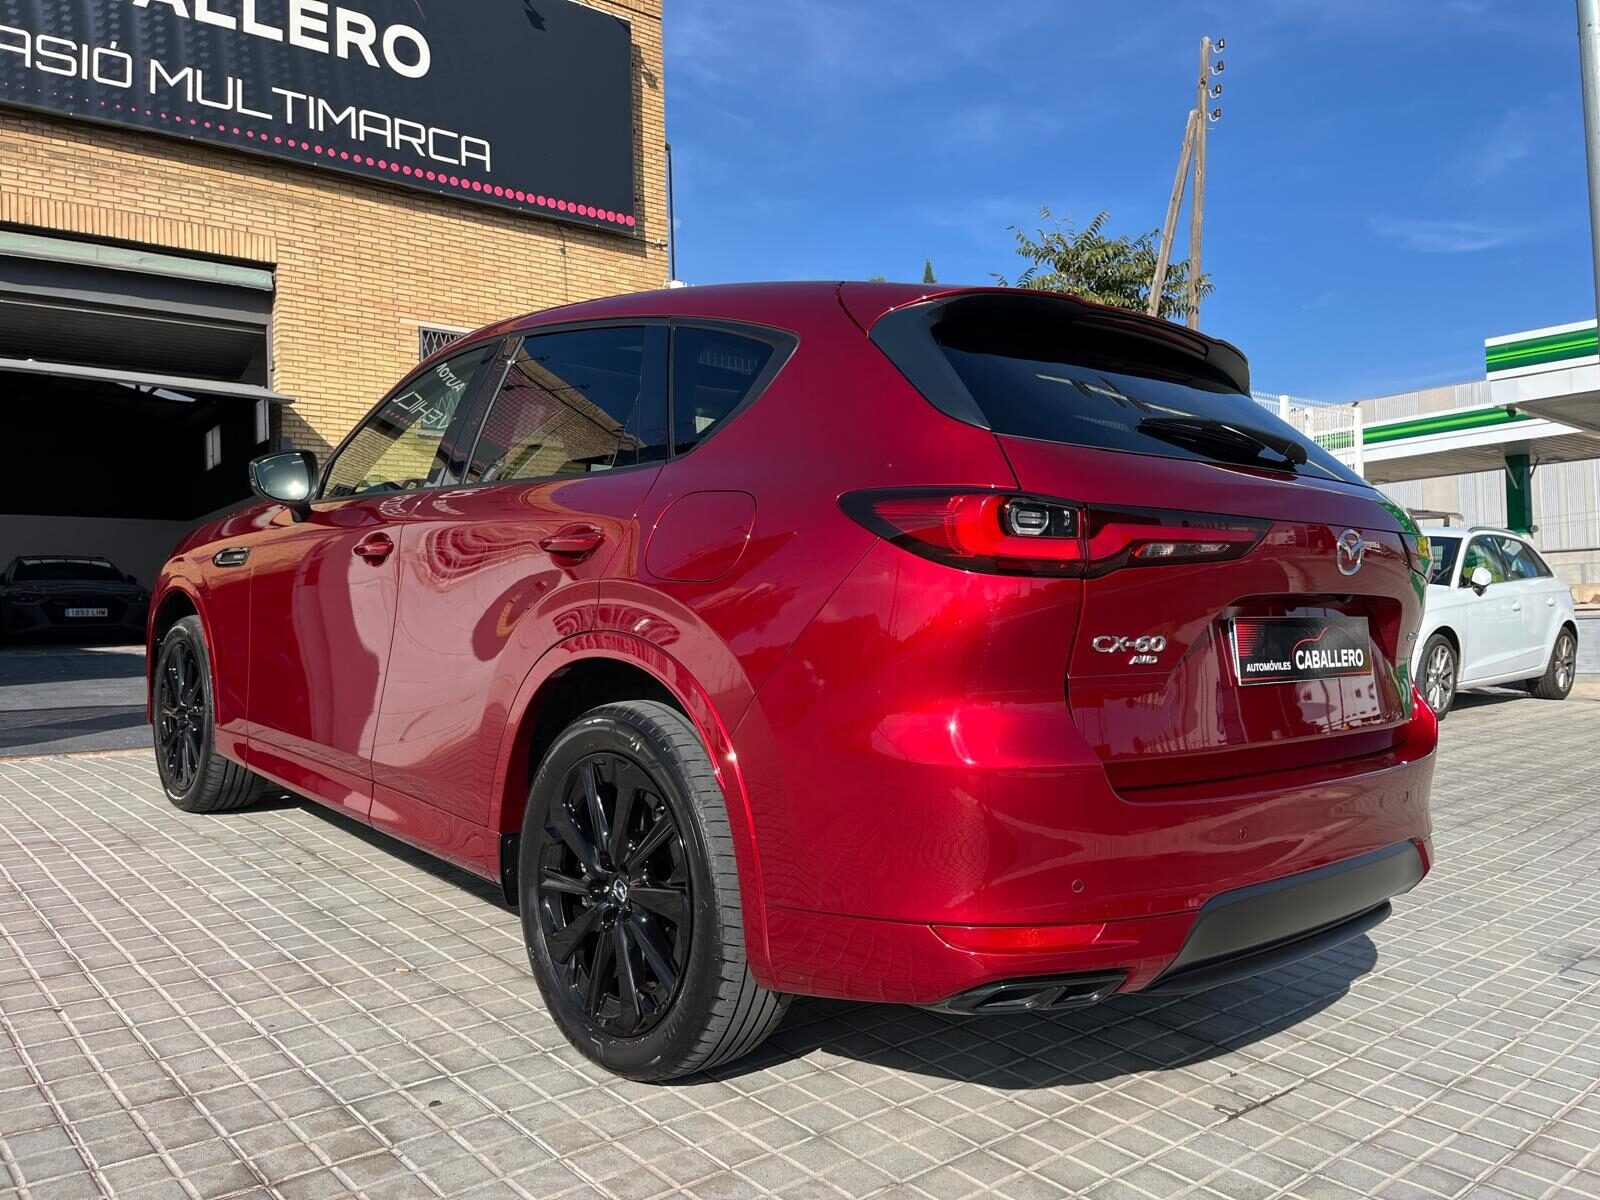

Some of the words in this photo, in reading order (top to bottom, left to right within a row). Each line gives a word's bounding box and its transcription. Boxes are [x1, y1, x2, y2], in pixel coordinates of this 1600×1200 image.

[149, 58, 491, 173] MULTIMARCA
[1092, 635, 1168, 653] CX-60
[1246, 660, 1292, 673] AUTOMÓVILES
[1295, 648, 1364, 670] CABALLERO
